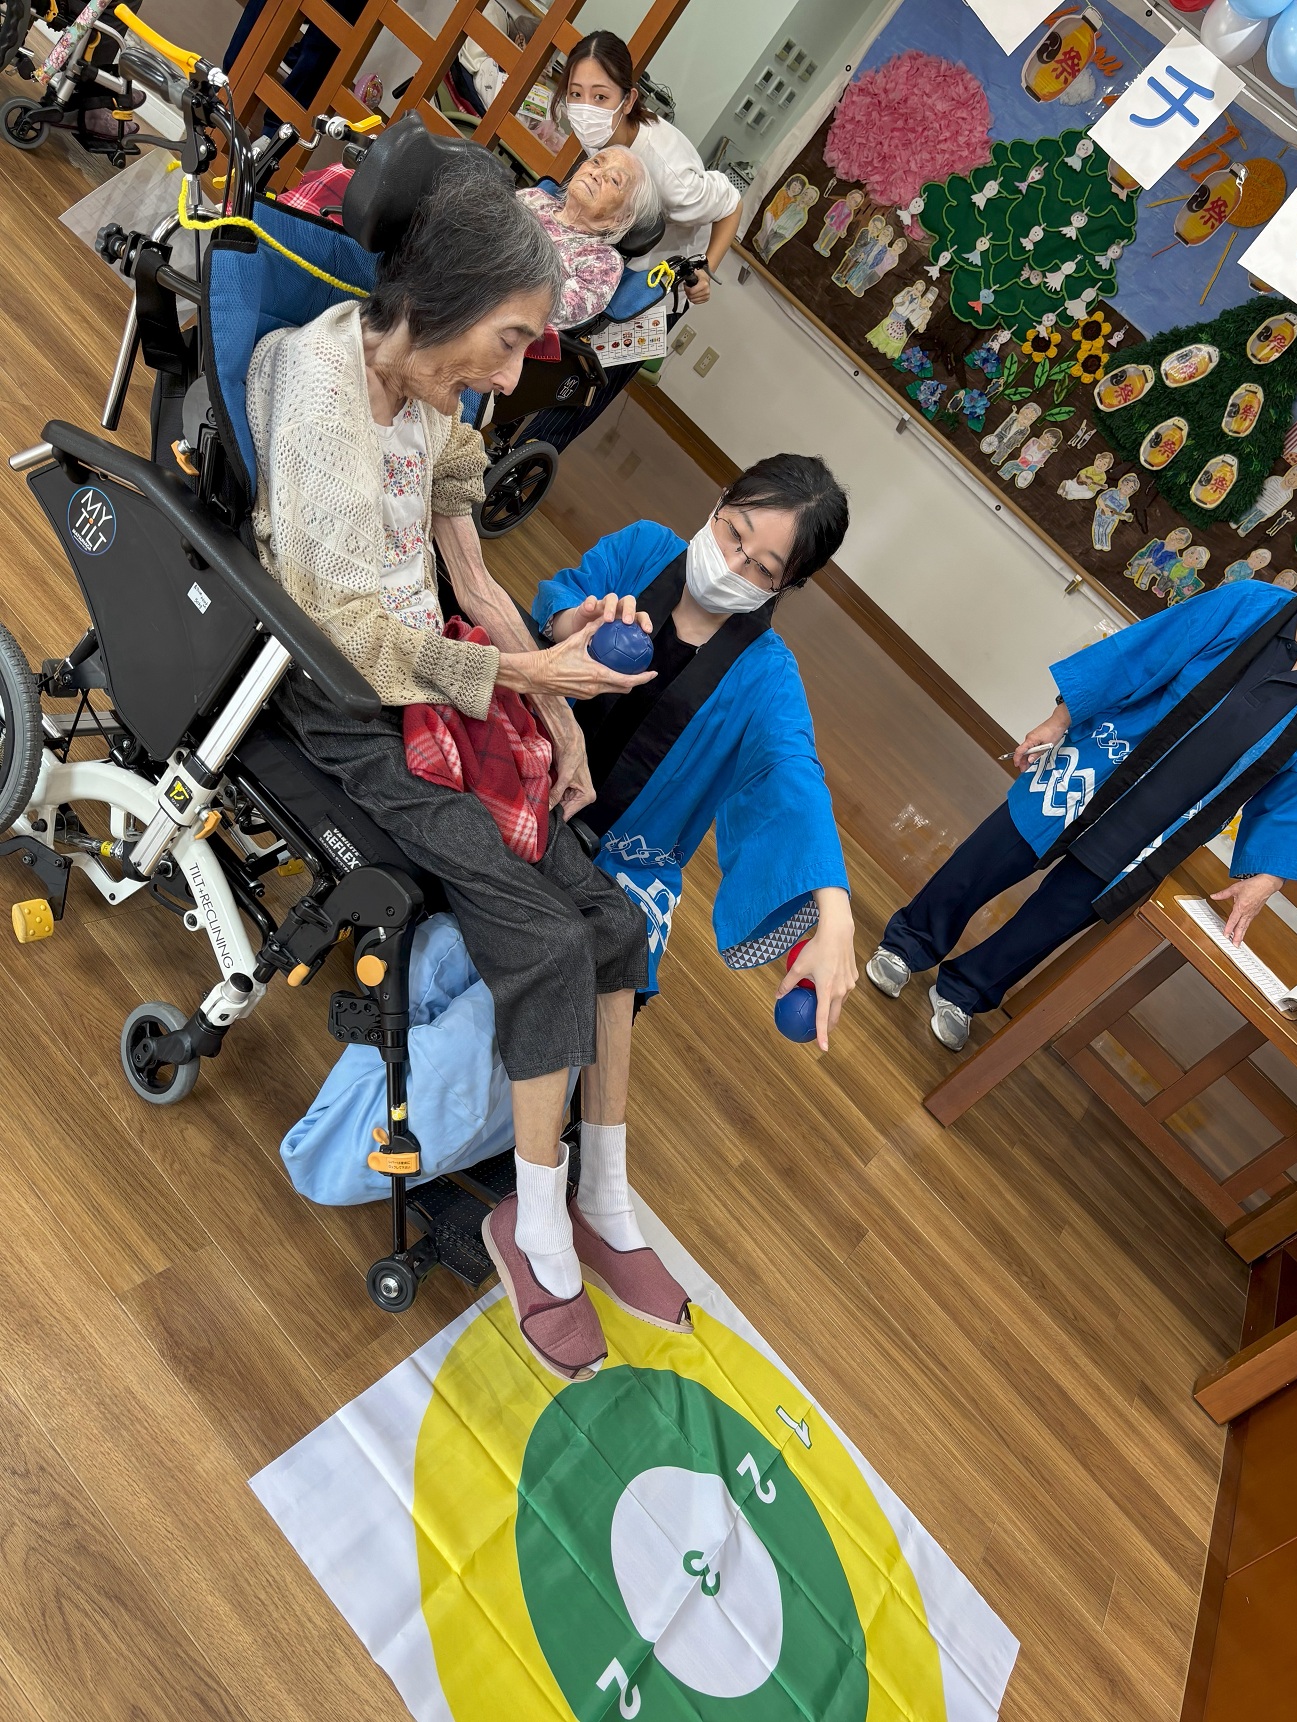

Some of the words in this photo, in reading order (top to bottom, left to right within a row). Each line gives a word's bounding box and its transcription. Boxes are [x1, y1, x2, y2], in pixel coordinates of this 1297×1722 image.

[1053, 46, 1082, 85] 祭
[1129, 65, 1215, 128] チ
[1200, 196, 1229, 230] 祭
[1114, 383, 1134, 403] 祭
[1239, 404, 1258, 423] 祭
[1159, 438, 1177, 458] 祭
[1210, 475, 1229, 494] 祭
[81, 489, 113, 527] MY
[323, 829, 360, 870] REFLEX
[775, 1404, 813, 1450] 1
[736, 1452, 777, 1504] 2
[682, 1549, 722, 1597] 3
[595, 1656, 642, 1721] 2
